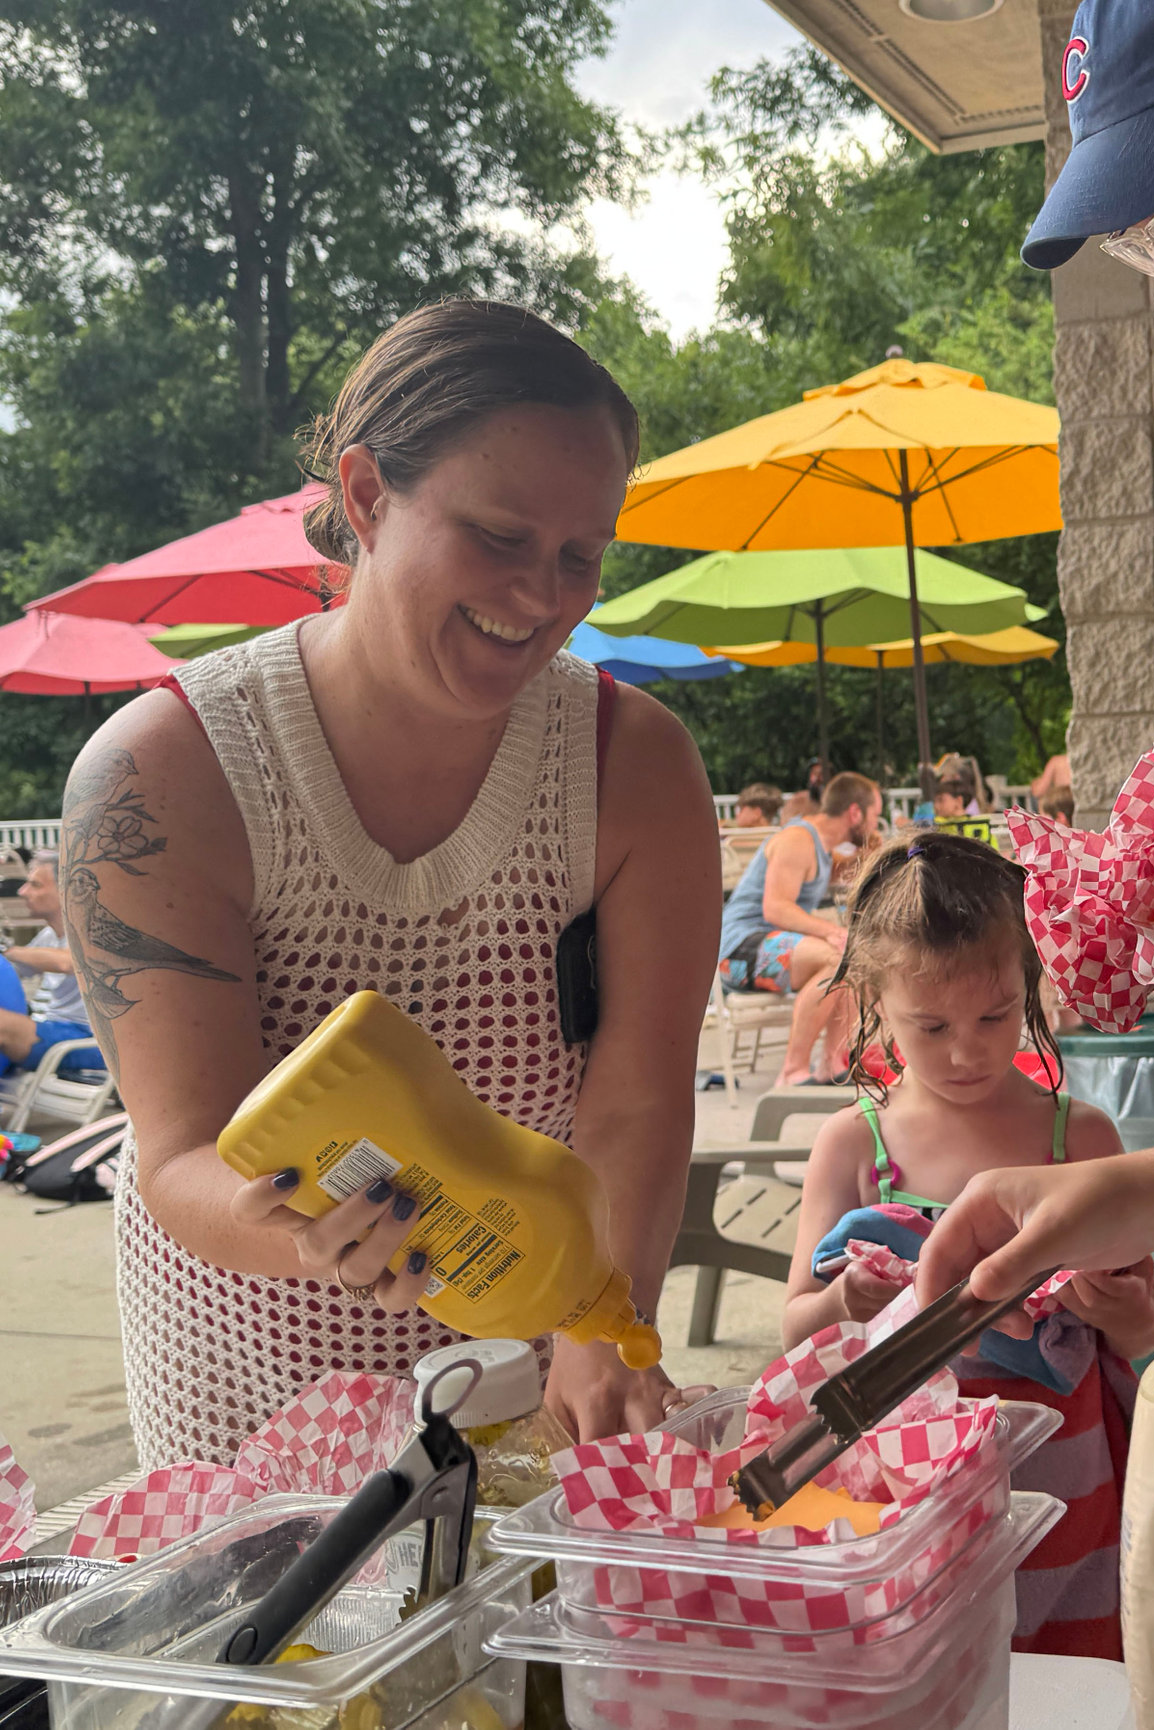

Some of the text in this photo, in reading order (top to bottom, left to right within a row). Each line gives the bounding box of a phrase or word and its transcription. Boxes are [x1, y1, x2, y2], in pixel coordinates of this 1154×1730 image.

[1062, 36, 1090, 104] C
[454, 1224, 487, 1254] Calories
[483, 1238, 503, 1257] Serving
[434, 1265, 447, 1276] 0
[475, 1254, 487, 1265] size
[466, 1249, 521, 1300] Nutrition Facts
